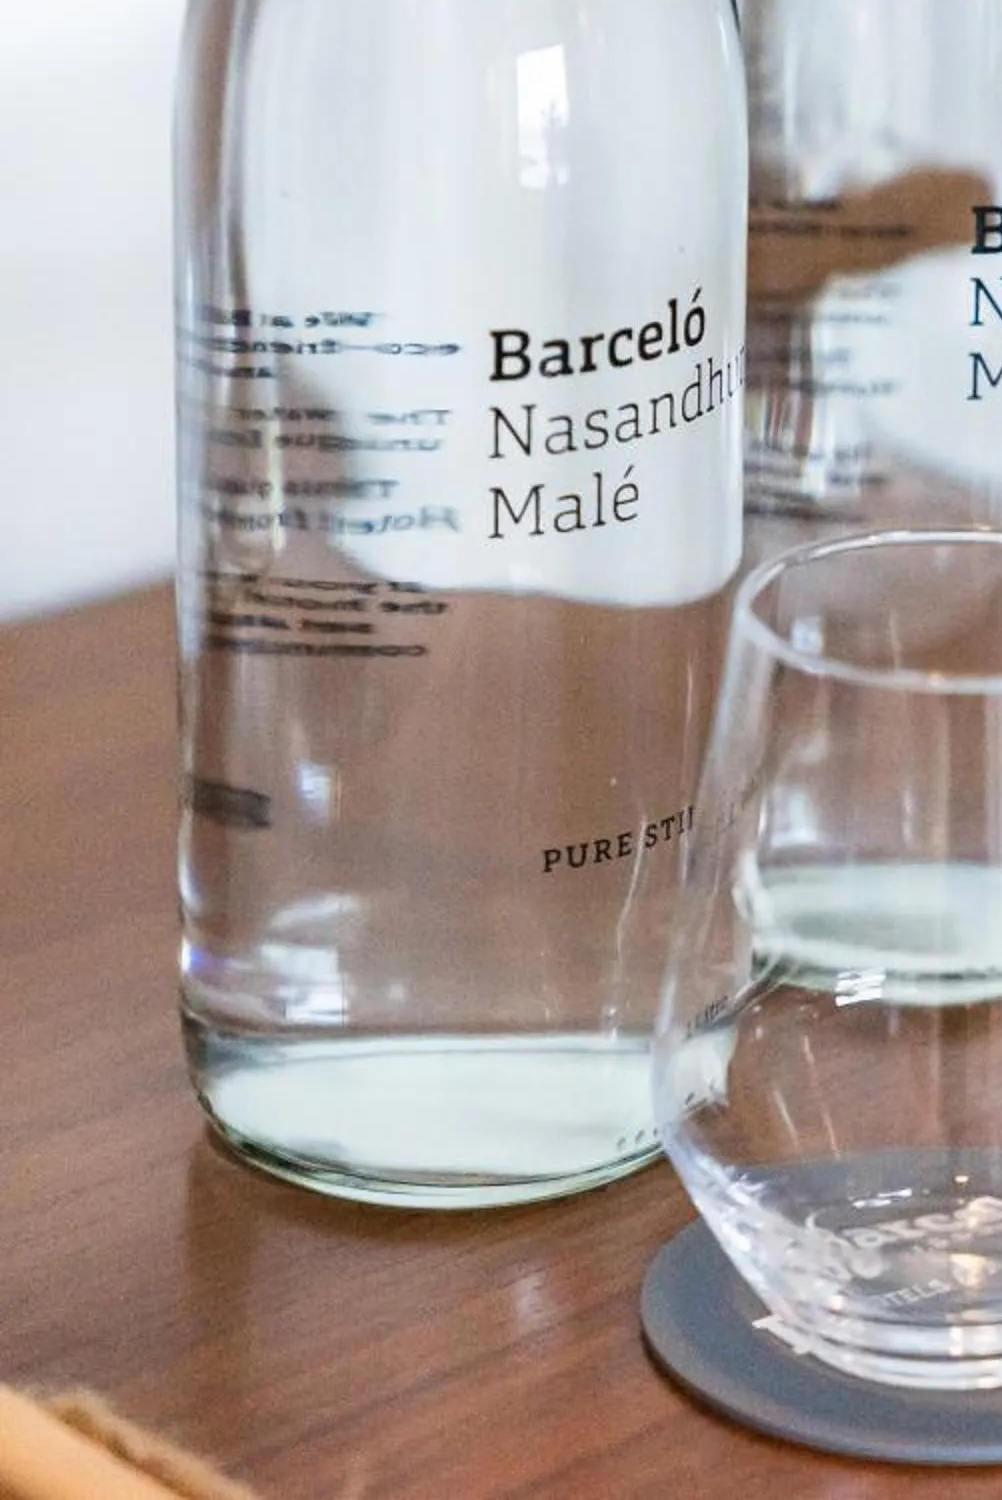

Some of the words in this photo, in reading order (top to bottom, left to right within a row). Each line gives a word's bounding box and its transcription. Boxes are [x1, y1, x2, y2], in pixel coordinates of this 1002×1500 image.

[489, 287, 706, 382] Barceló
[488, 464, 640, 539] Malé
[542, 831, 633, 873] PURE
